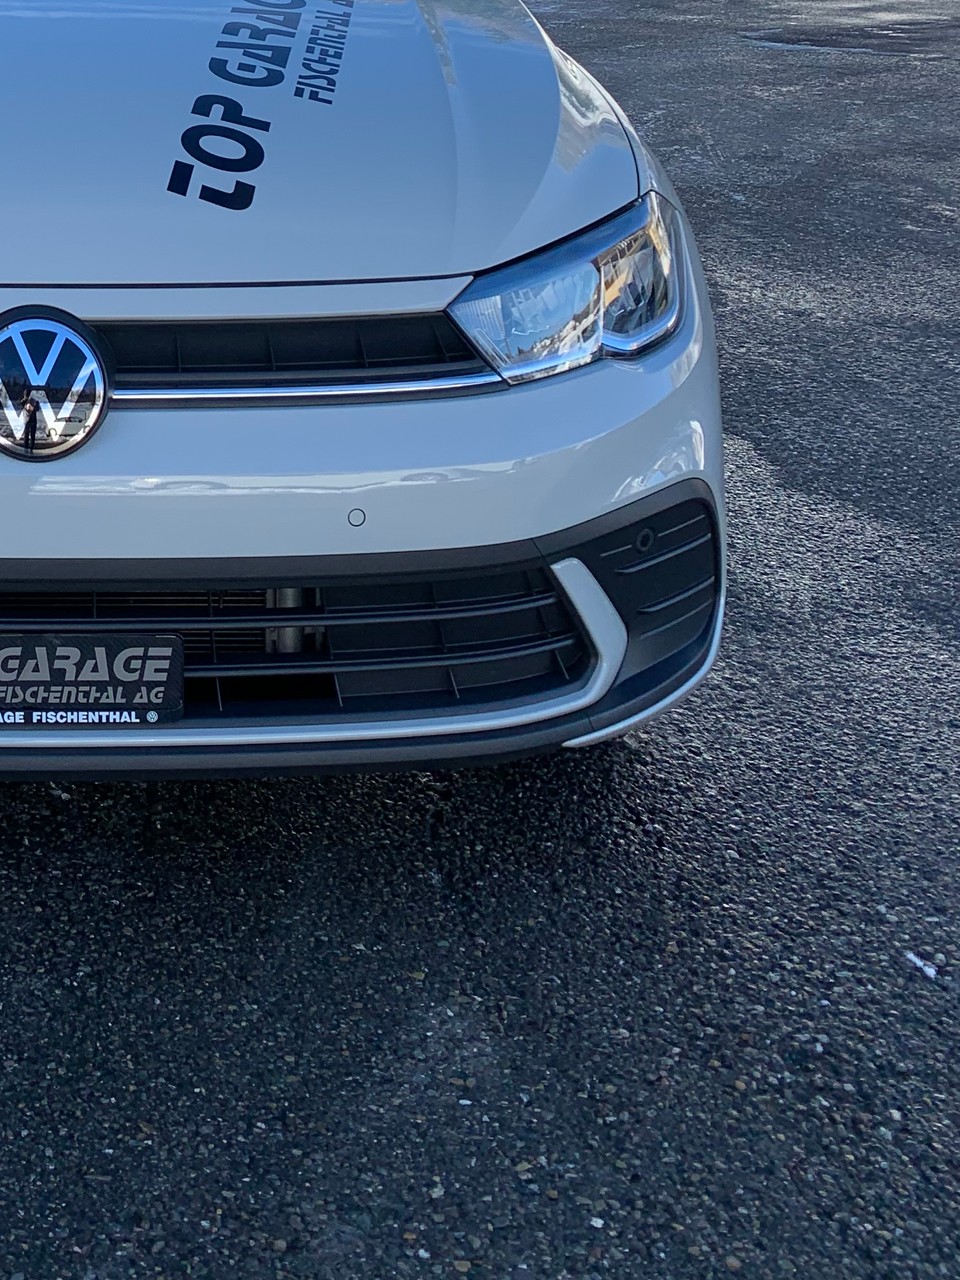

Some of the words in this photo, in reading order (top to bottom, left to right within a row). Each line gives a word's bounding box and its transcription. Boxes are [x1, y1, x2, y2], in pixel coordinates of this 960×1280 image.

[293, 10, 352, 105] FISCHENTHAL
[167, 94, 271, 211] TOP
[32, 710, 140, 723] FISCHENTHAL
[133, 686, 165, 704] AG
